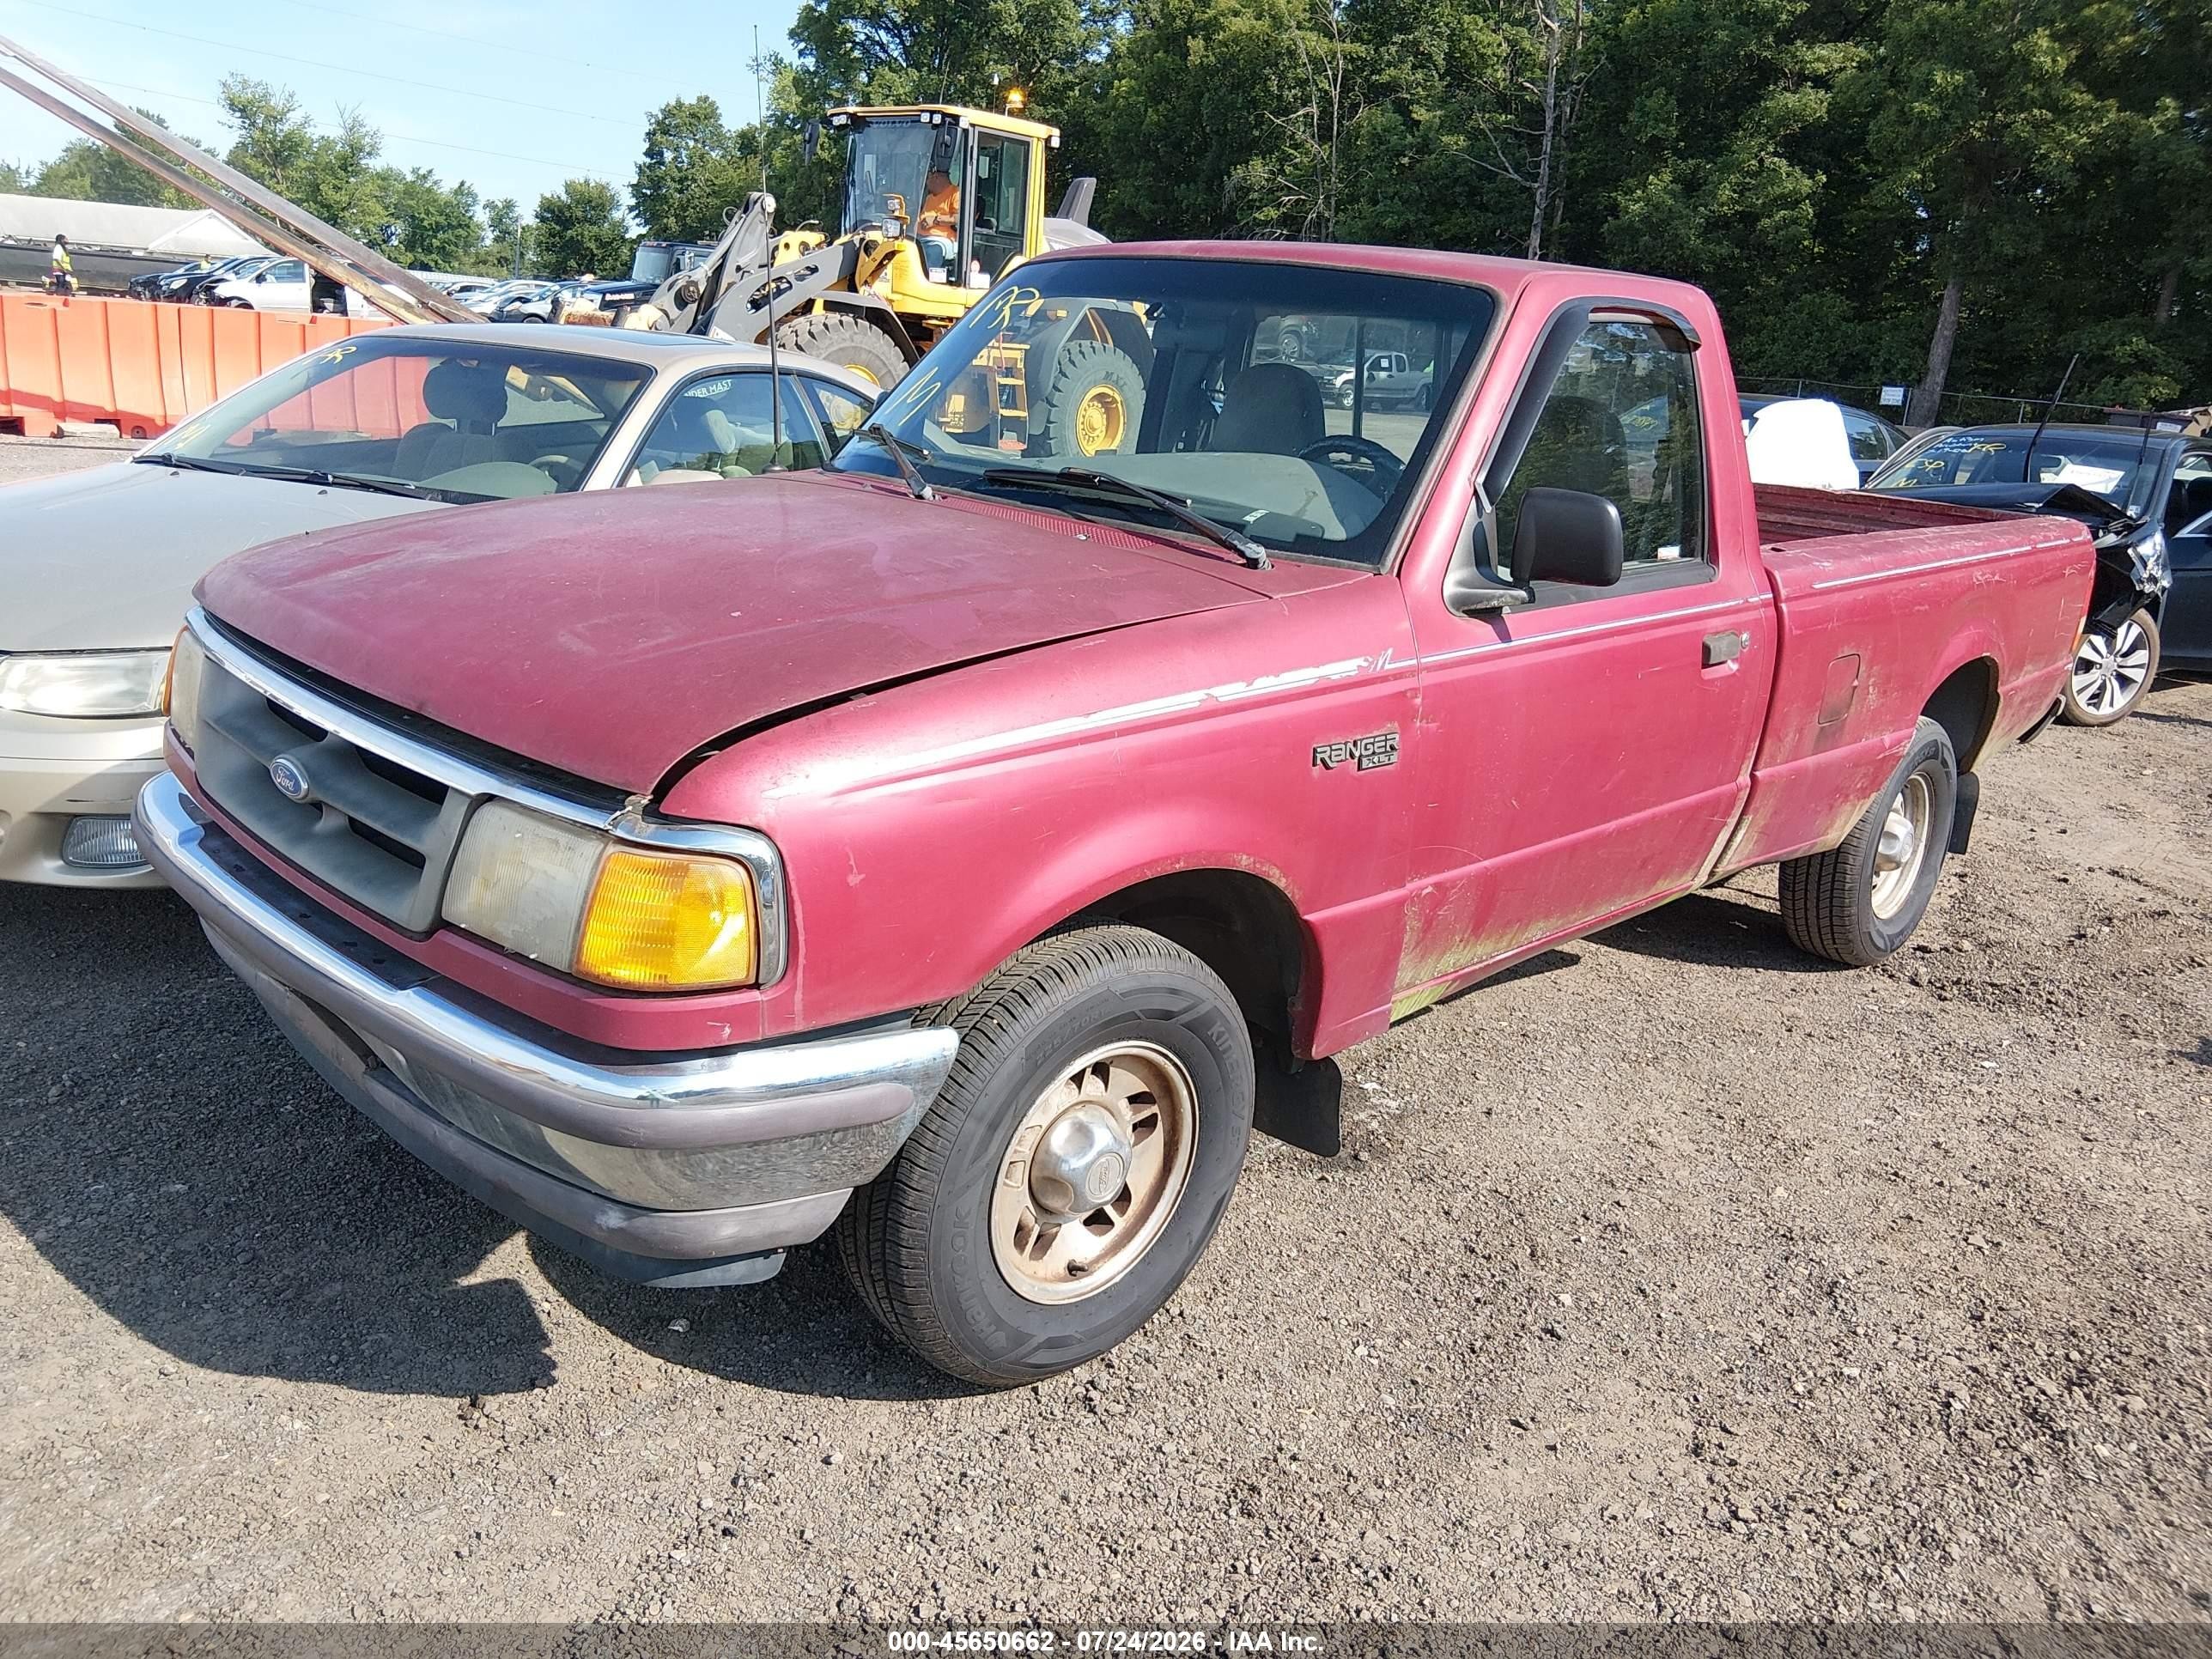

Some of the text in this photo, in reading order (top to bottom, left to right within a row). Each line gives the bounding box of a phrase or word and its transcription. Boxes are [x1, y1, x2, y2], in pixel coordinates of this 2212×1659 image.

[1312, 732, 1401, 770] RANGER
[1366, 753, 1395, 767] XLT
[276, 766, 295, 792] Ford
